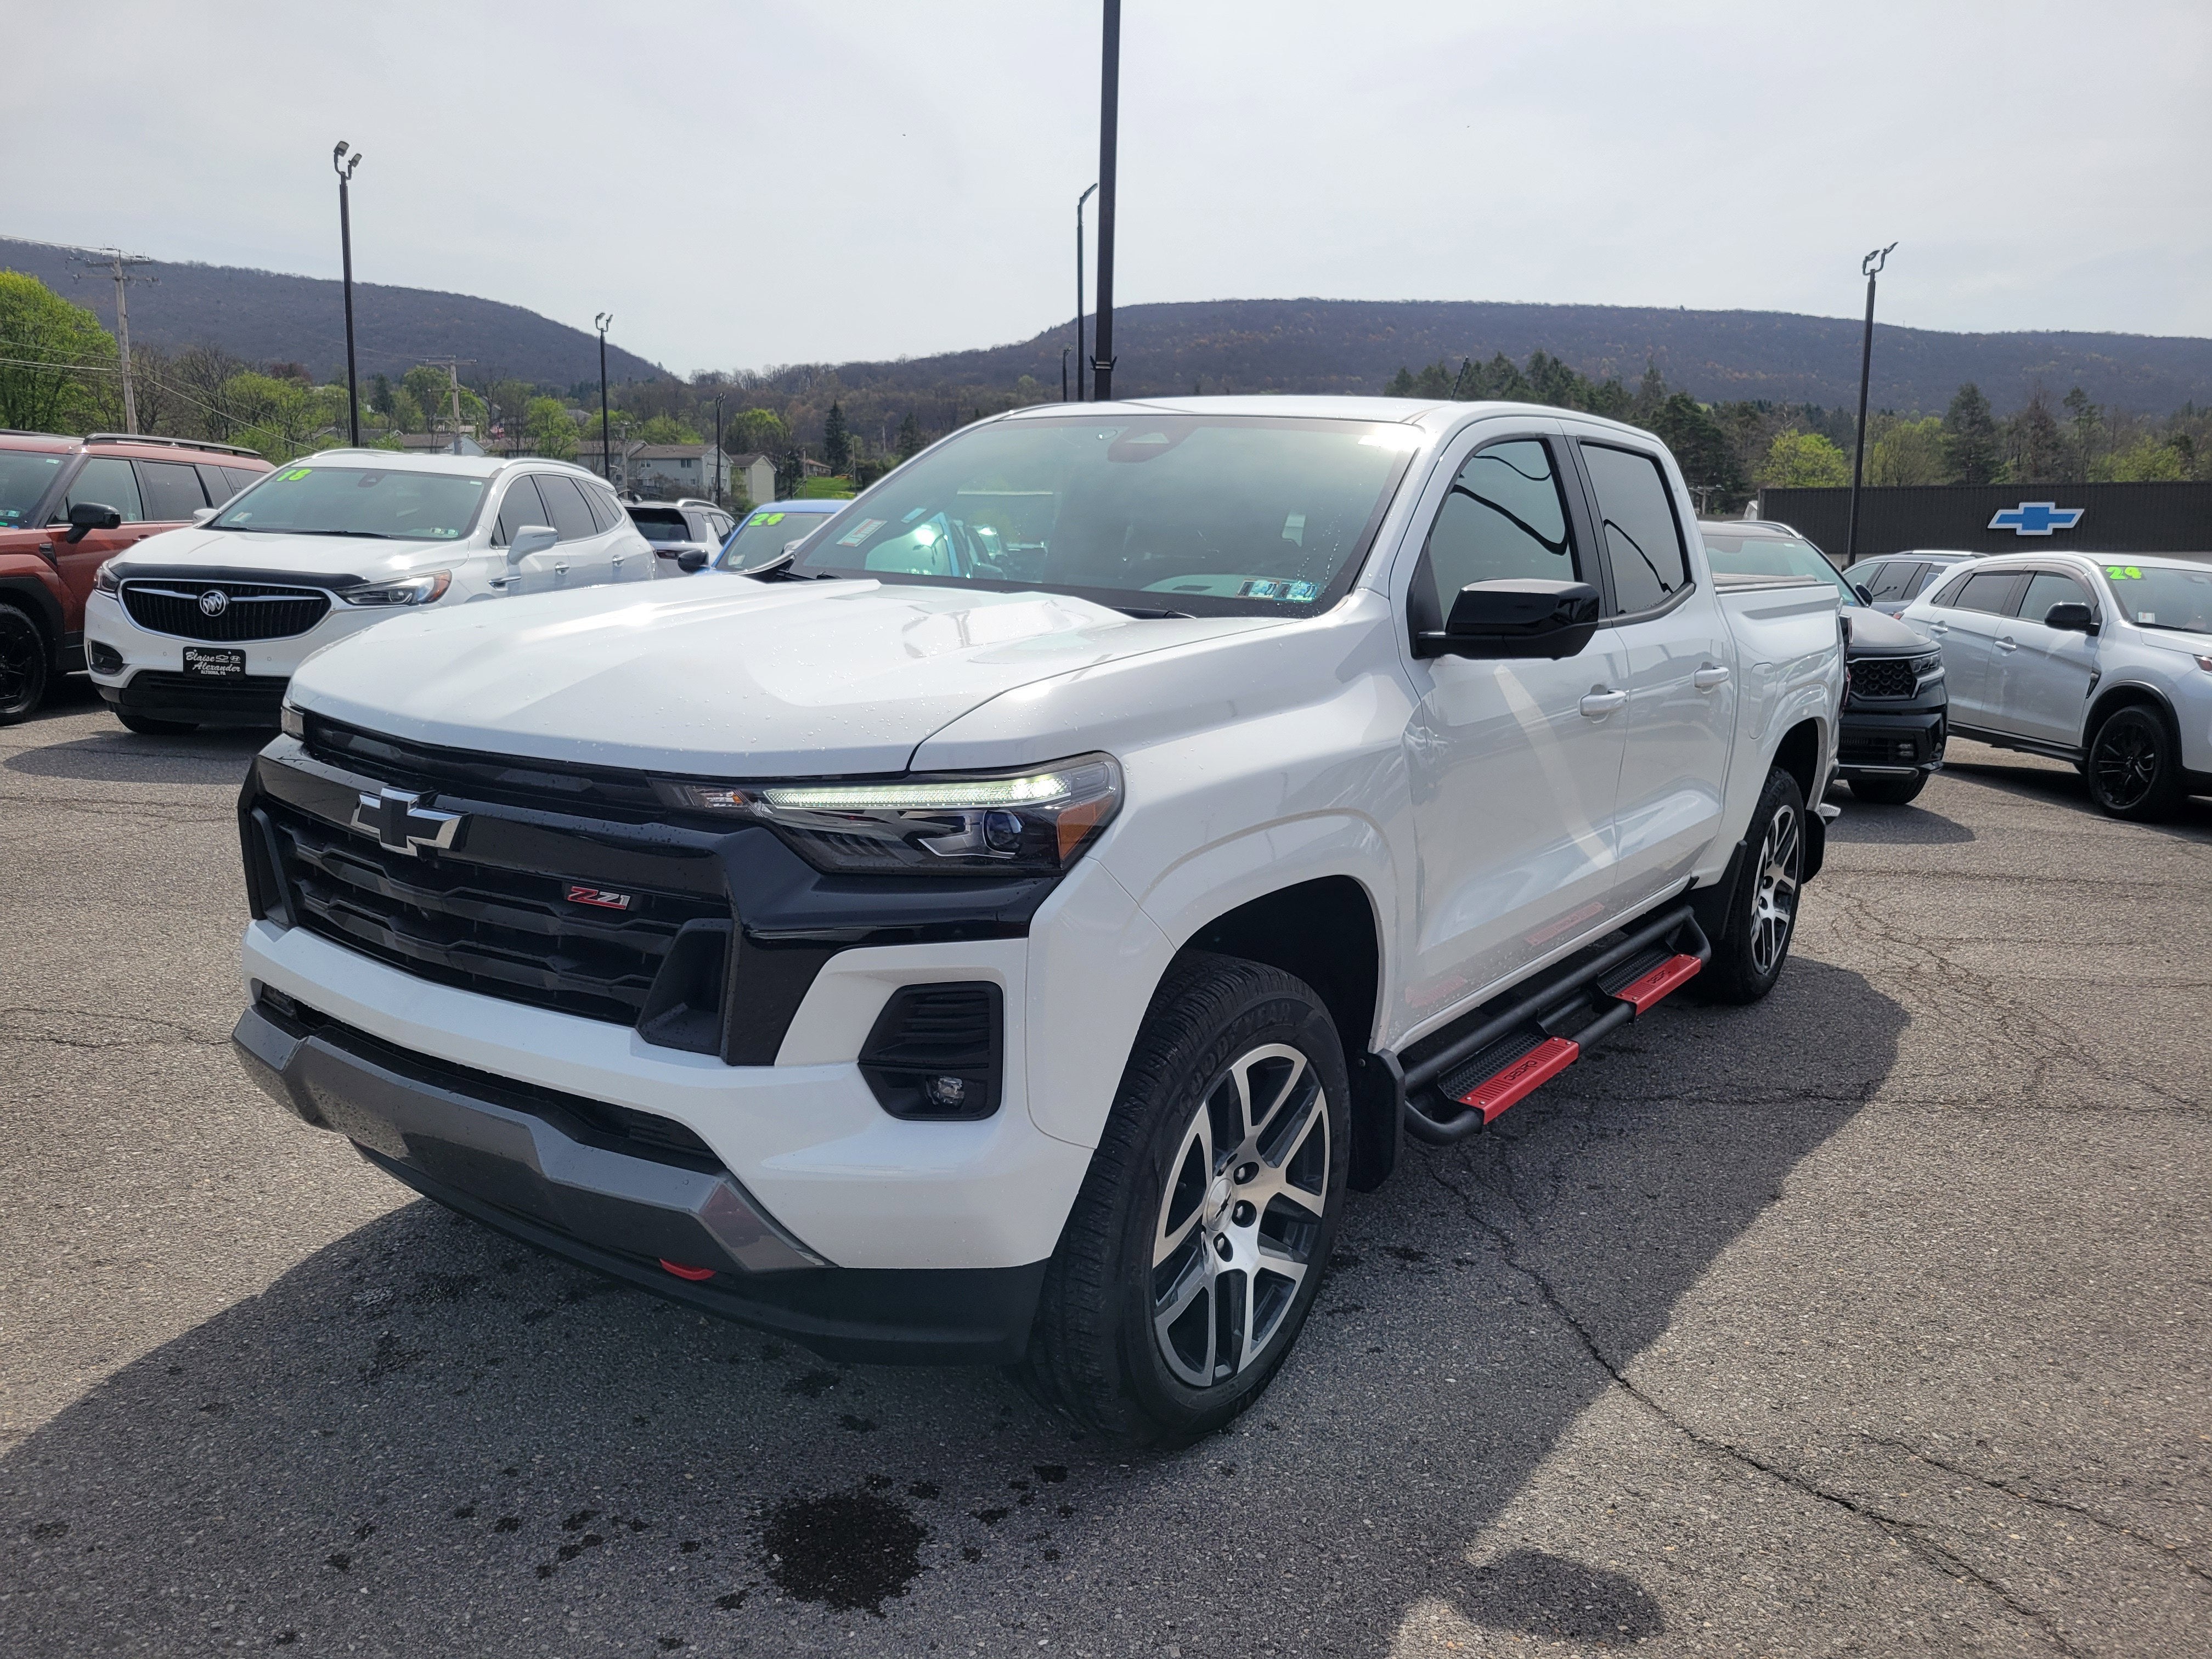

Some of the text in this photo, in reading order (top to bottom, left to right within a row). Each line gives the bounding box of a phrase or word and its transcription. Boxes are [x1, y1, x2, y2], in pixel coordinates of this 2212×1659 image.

[276, 469, 313, 482] 18
[749, 513, 786, 526] 24
[185, 651, 216, 662] Blaise
[192, 661, 241, 672] Alexander
[567, 885, 631, 910] Z71
